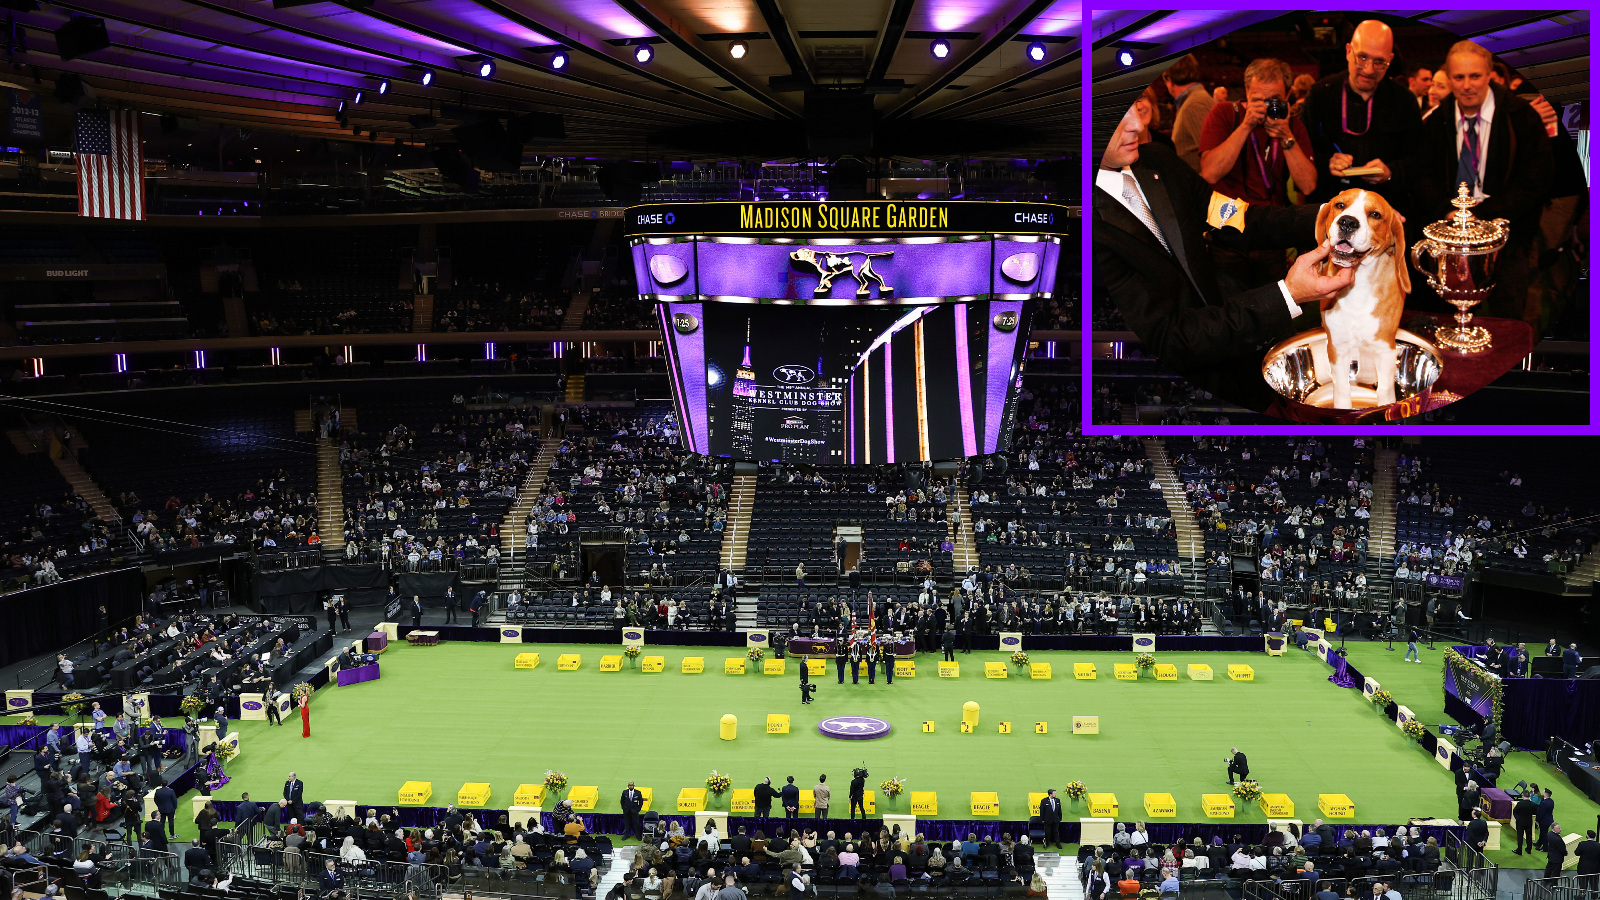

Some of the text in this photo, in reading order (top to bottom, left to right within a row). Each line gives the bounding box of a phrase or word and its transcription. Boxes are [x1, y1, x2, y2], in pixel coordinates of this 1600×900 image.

[11, 106, 40, 117] 2012-13
[13, 128, 41, 137] CHAMPIONS
[558, 210, 589, 218] CHASE
[637, 214, 663, 225] CHASE
[740, 204, 948, 230] MADISON SQUARE GARDEN
[1014, 212, 1048, 223] CHASE
[749, 390, 842, 401] WESTMINSTER
[765, 436, 825, 446] #WestminsterDogShow
